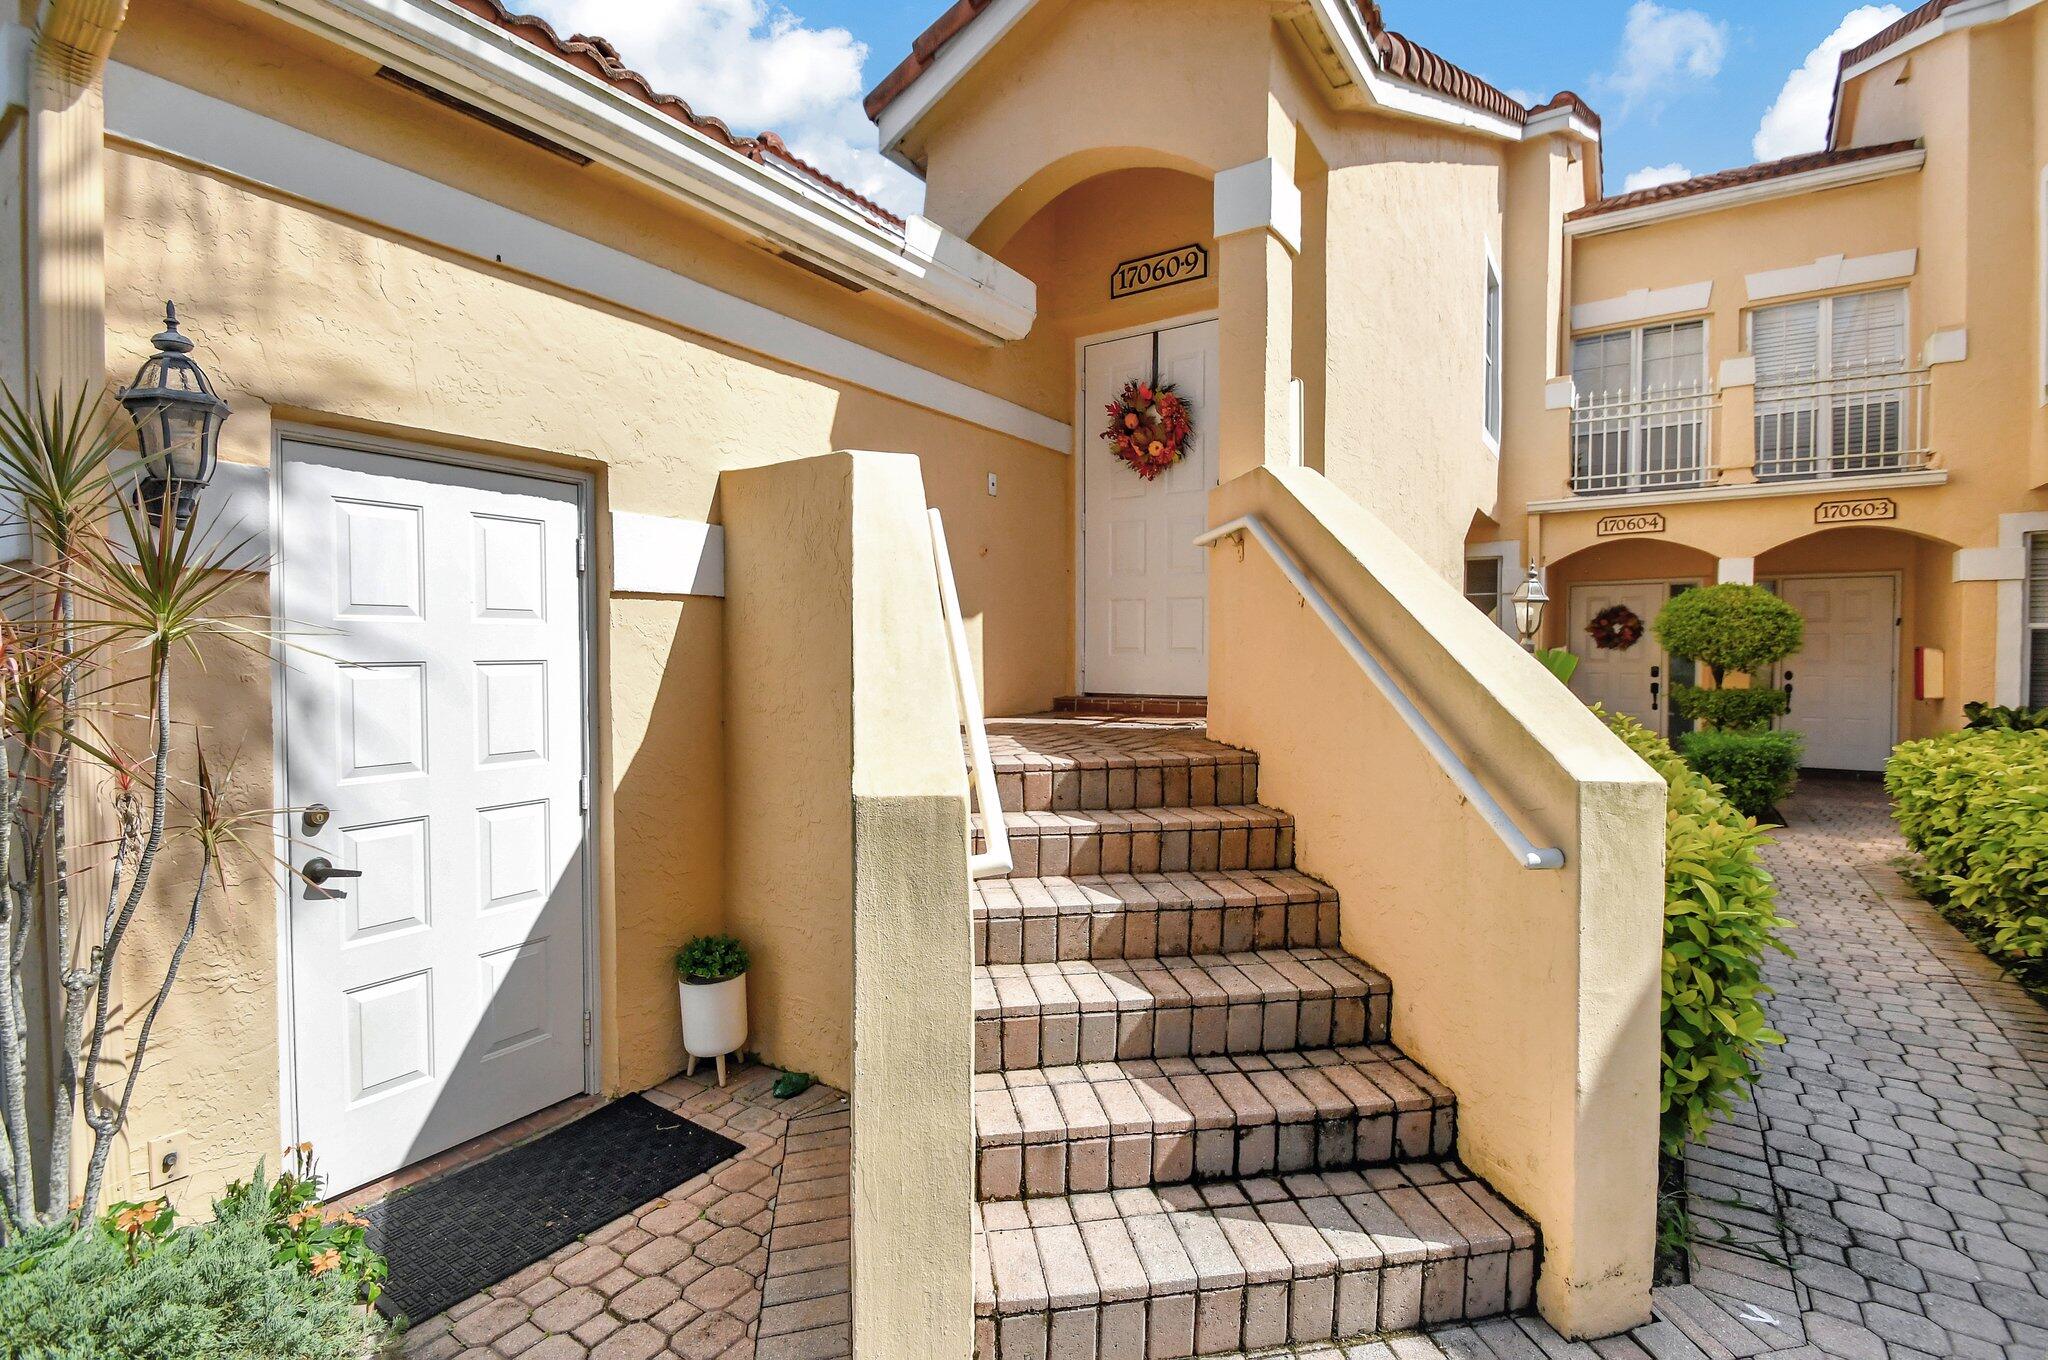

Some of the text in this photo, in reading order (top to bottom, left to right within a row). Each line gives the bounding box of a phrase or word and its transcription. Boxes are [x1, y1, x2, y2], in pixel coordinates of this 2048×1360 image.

[1119, 251, 1199, 290] 17060-9
[1822, 501, 1889, 519] 17060-3
[1602, 516, 1659, 532] 17060-4
